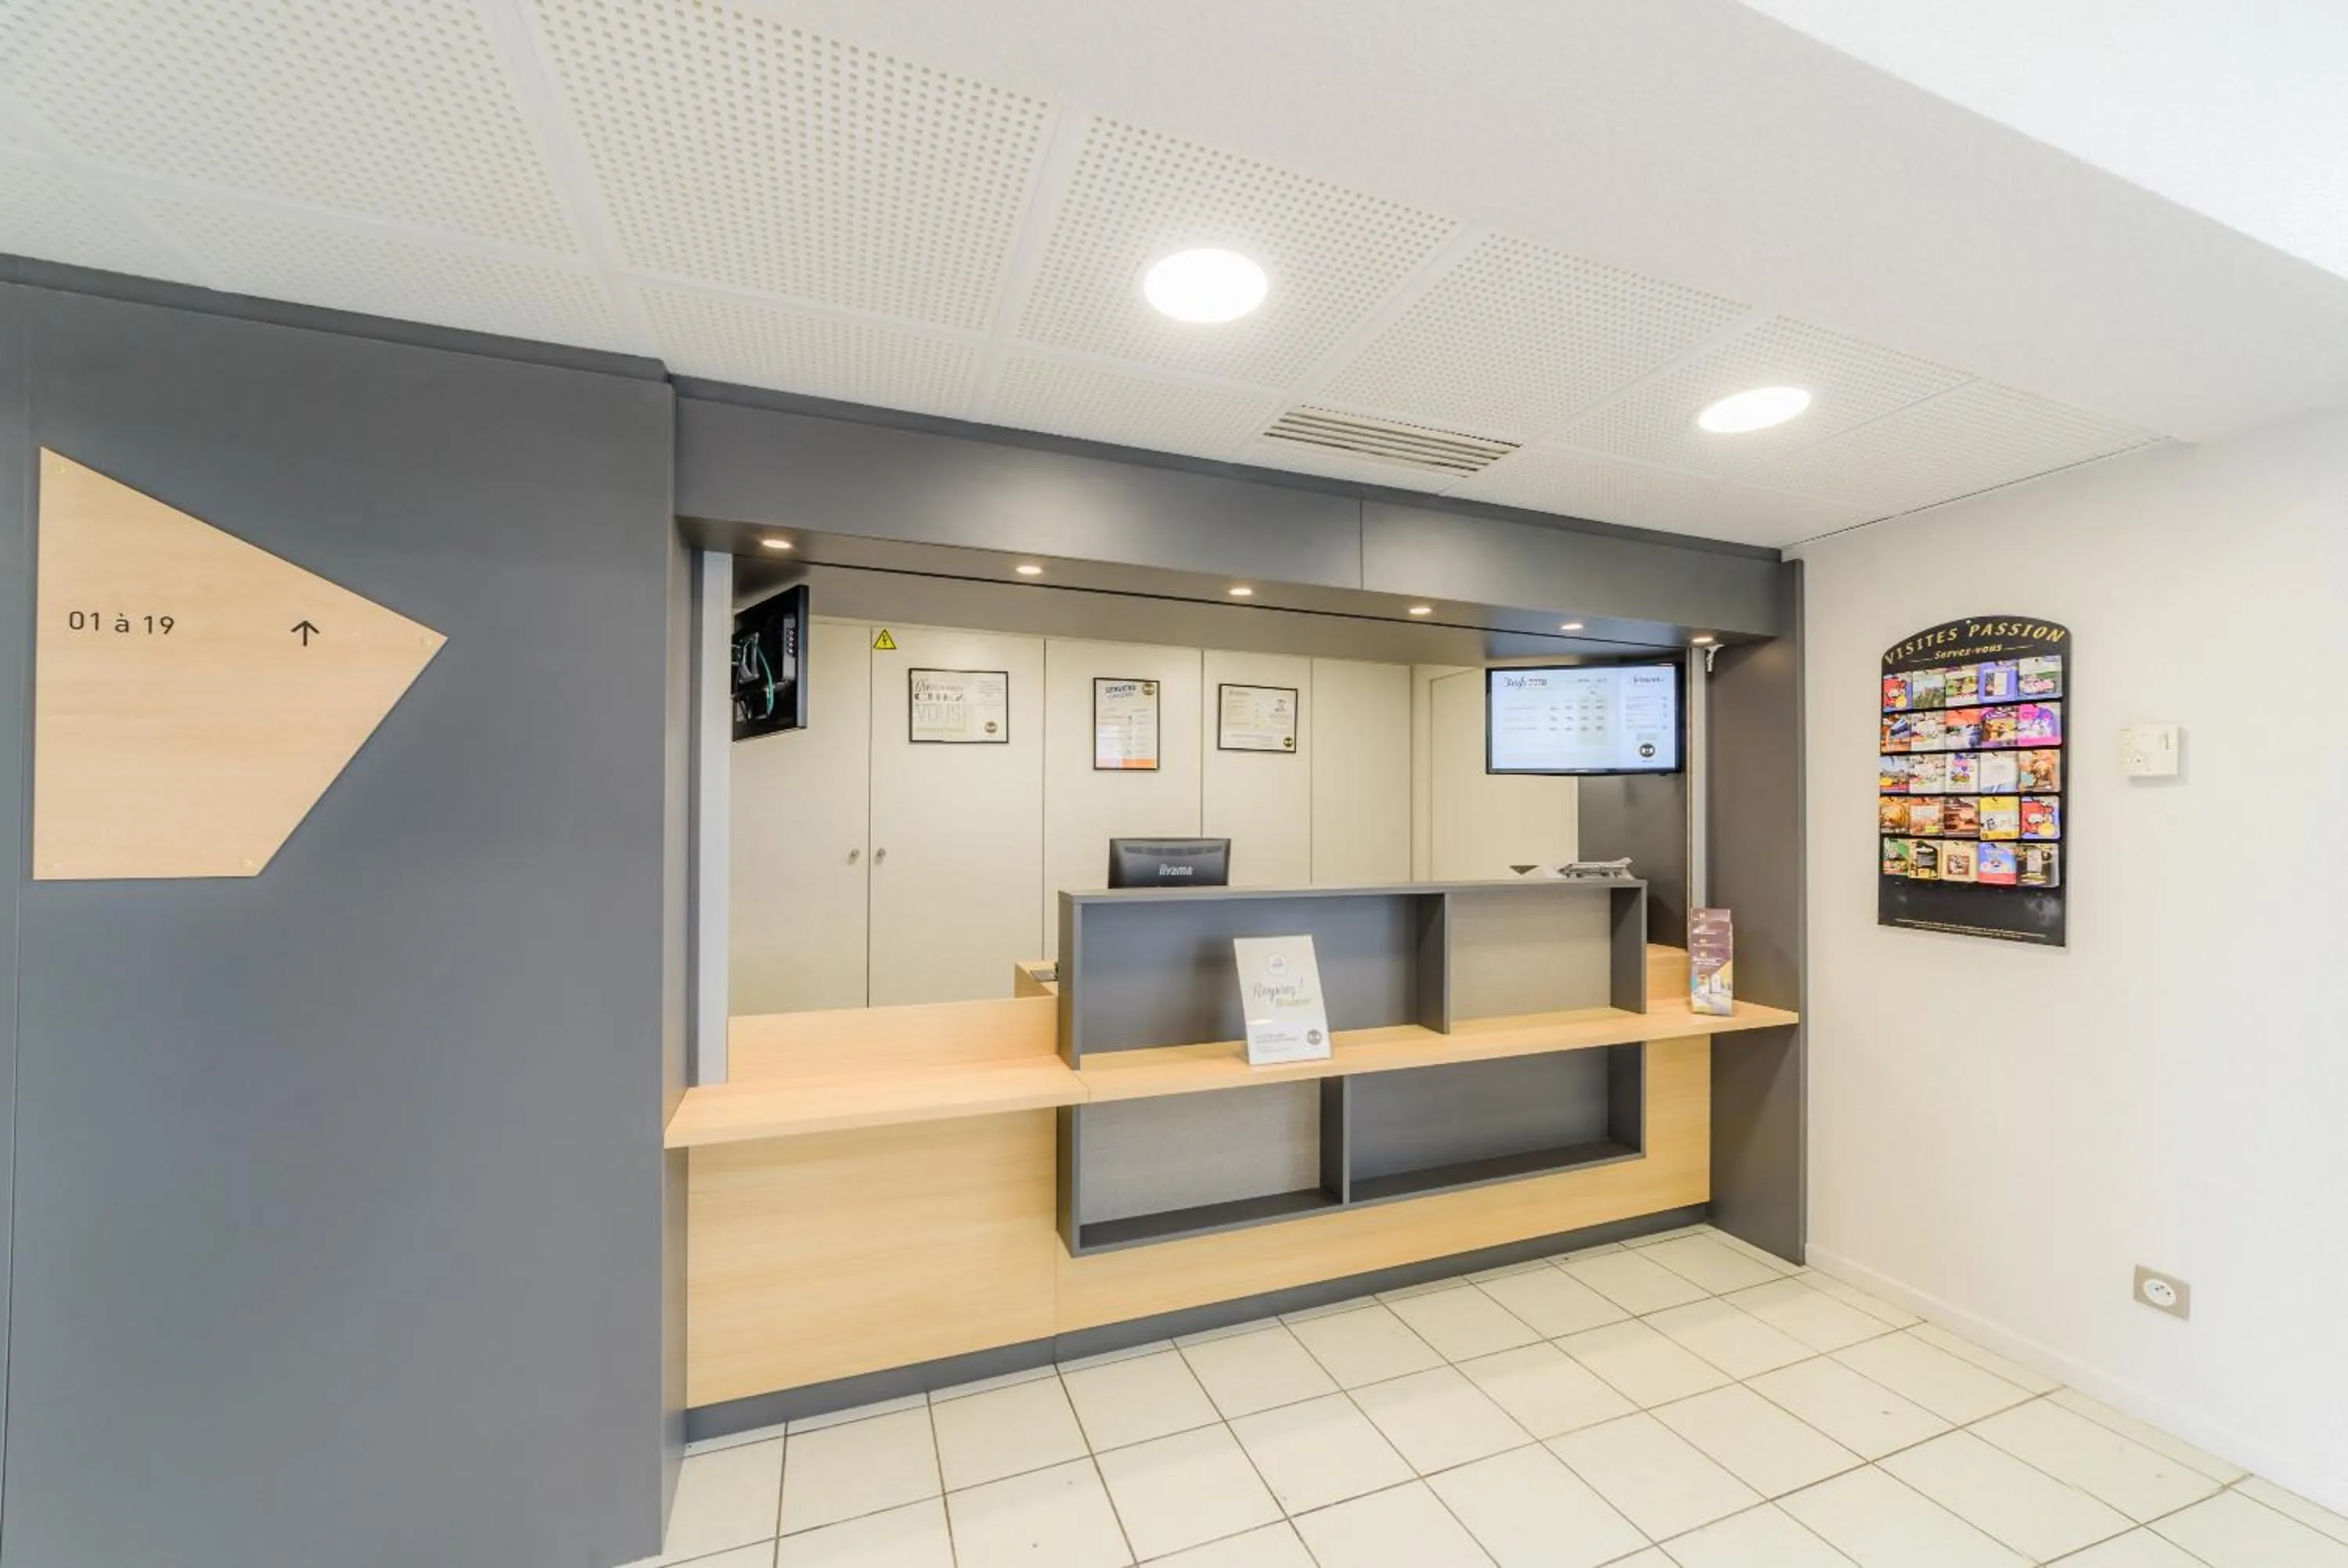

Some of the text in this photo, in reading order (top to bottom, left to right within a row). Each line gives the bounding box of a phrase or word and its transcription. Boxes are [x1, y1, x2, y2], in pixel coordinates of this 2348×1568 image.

[69, 611, 175, 635] 01 à 19
[1884, 622, 2066, 664] VISITES PASSION
[914, 703, 960, 721] VOUS
